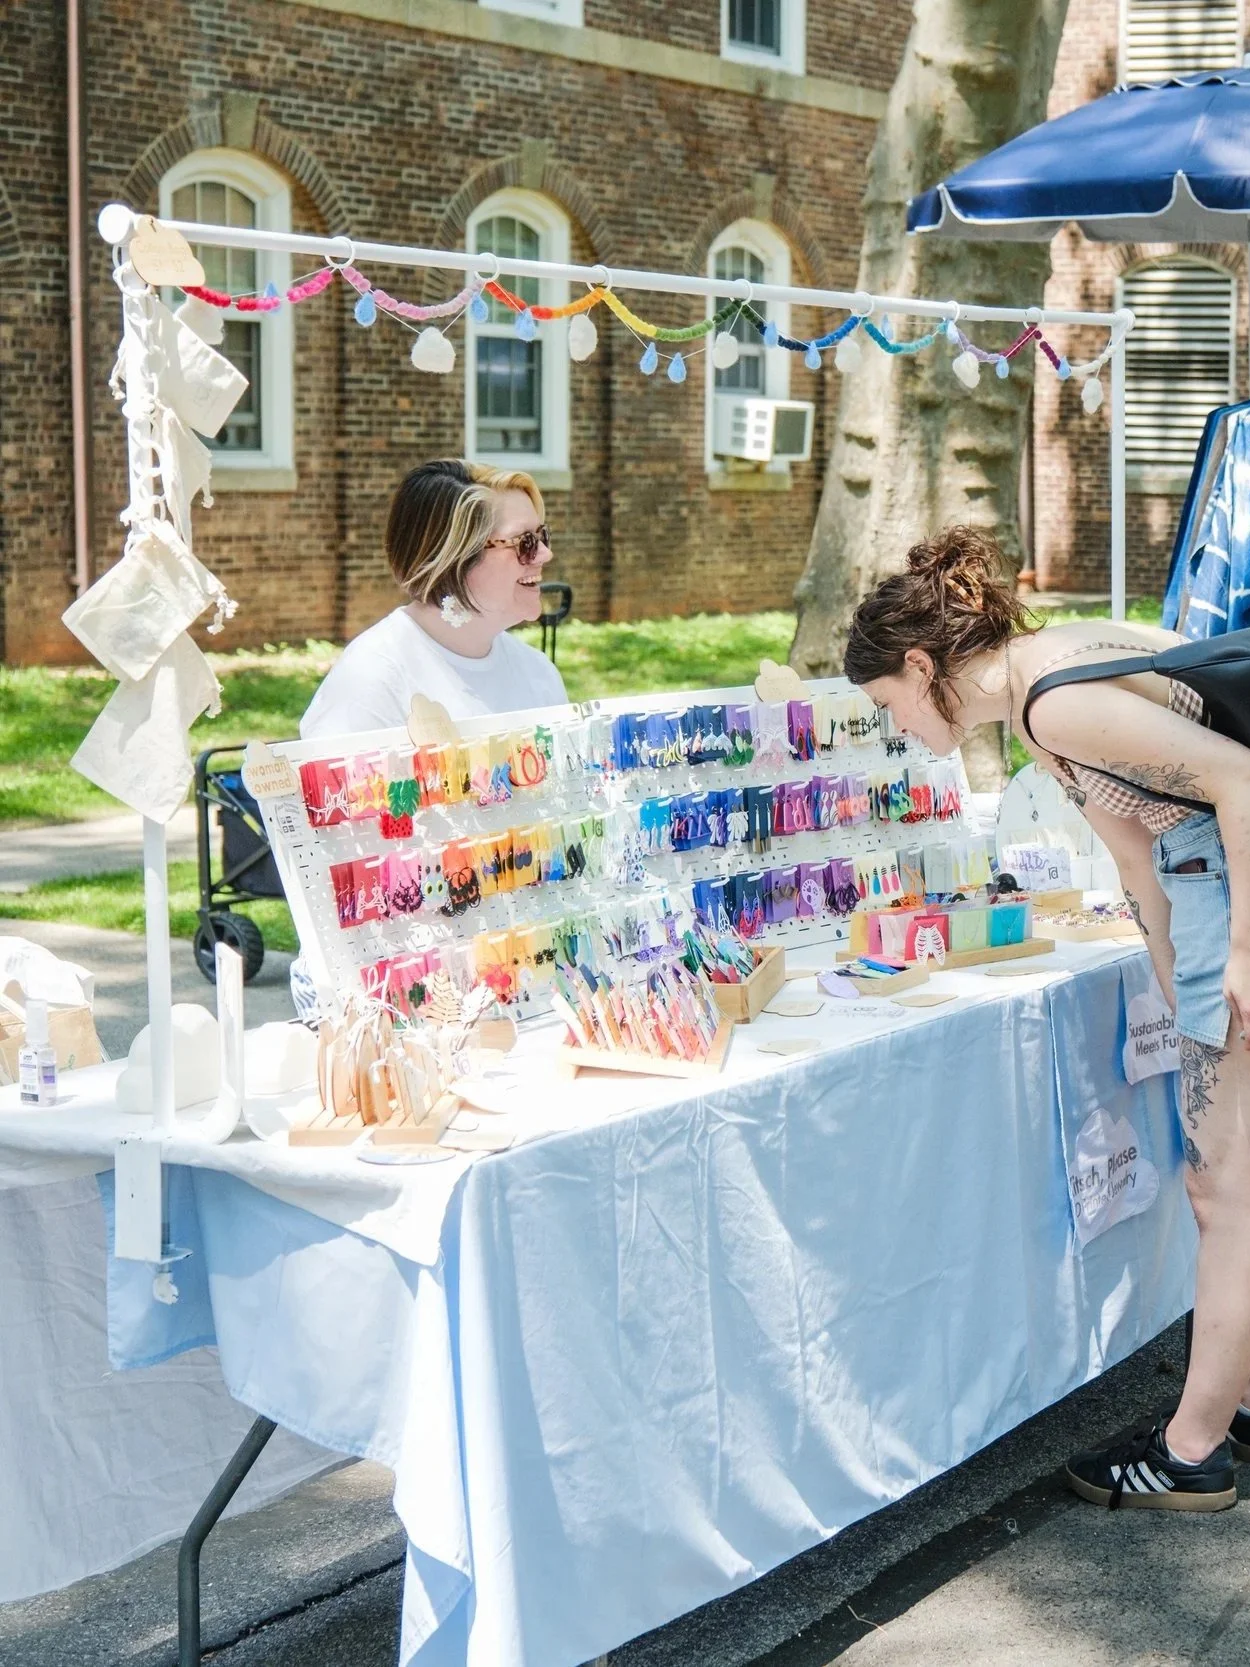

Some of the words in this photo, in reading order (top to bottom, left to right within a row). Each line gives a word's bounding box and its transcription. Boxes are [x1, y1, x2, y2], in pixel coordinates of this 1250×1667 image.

[250, 761, 287, 777] woman
[254, 776, 291, 793] owned
[1128, 1013, 1175, 1039] Sustainabi
